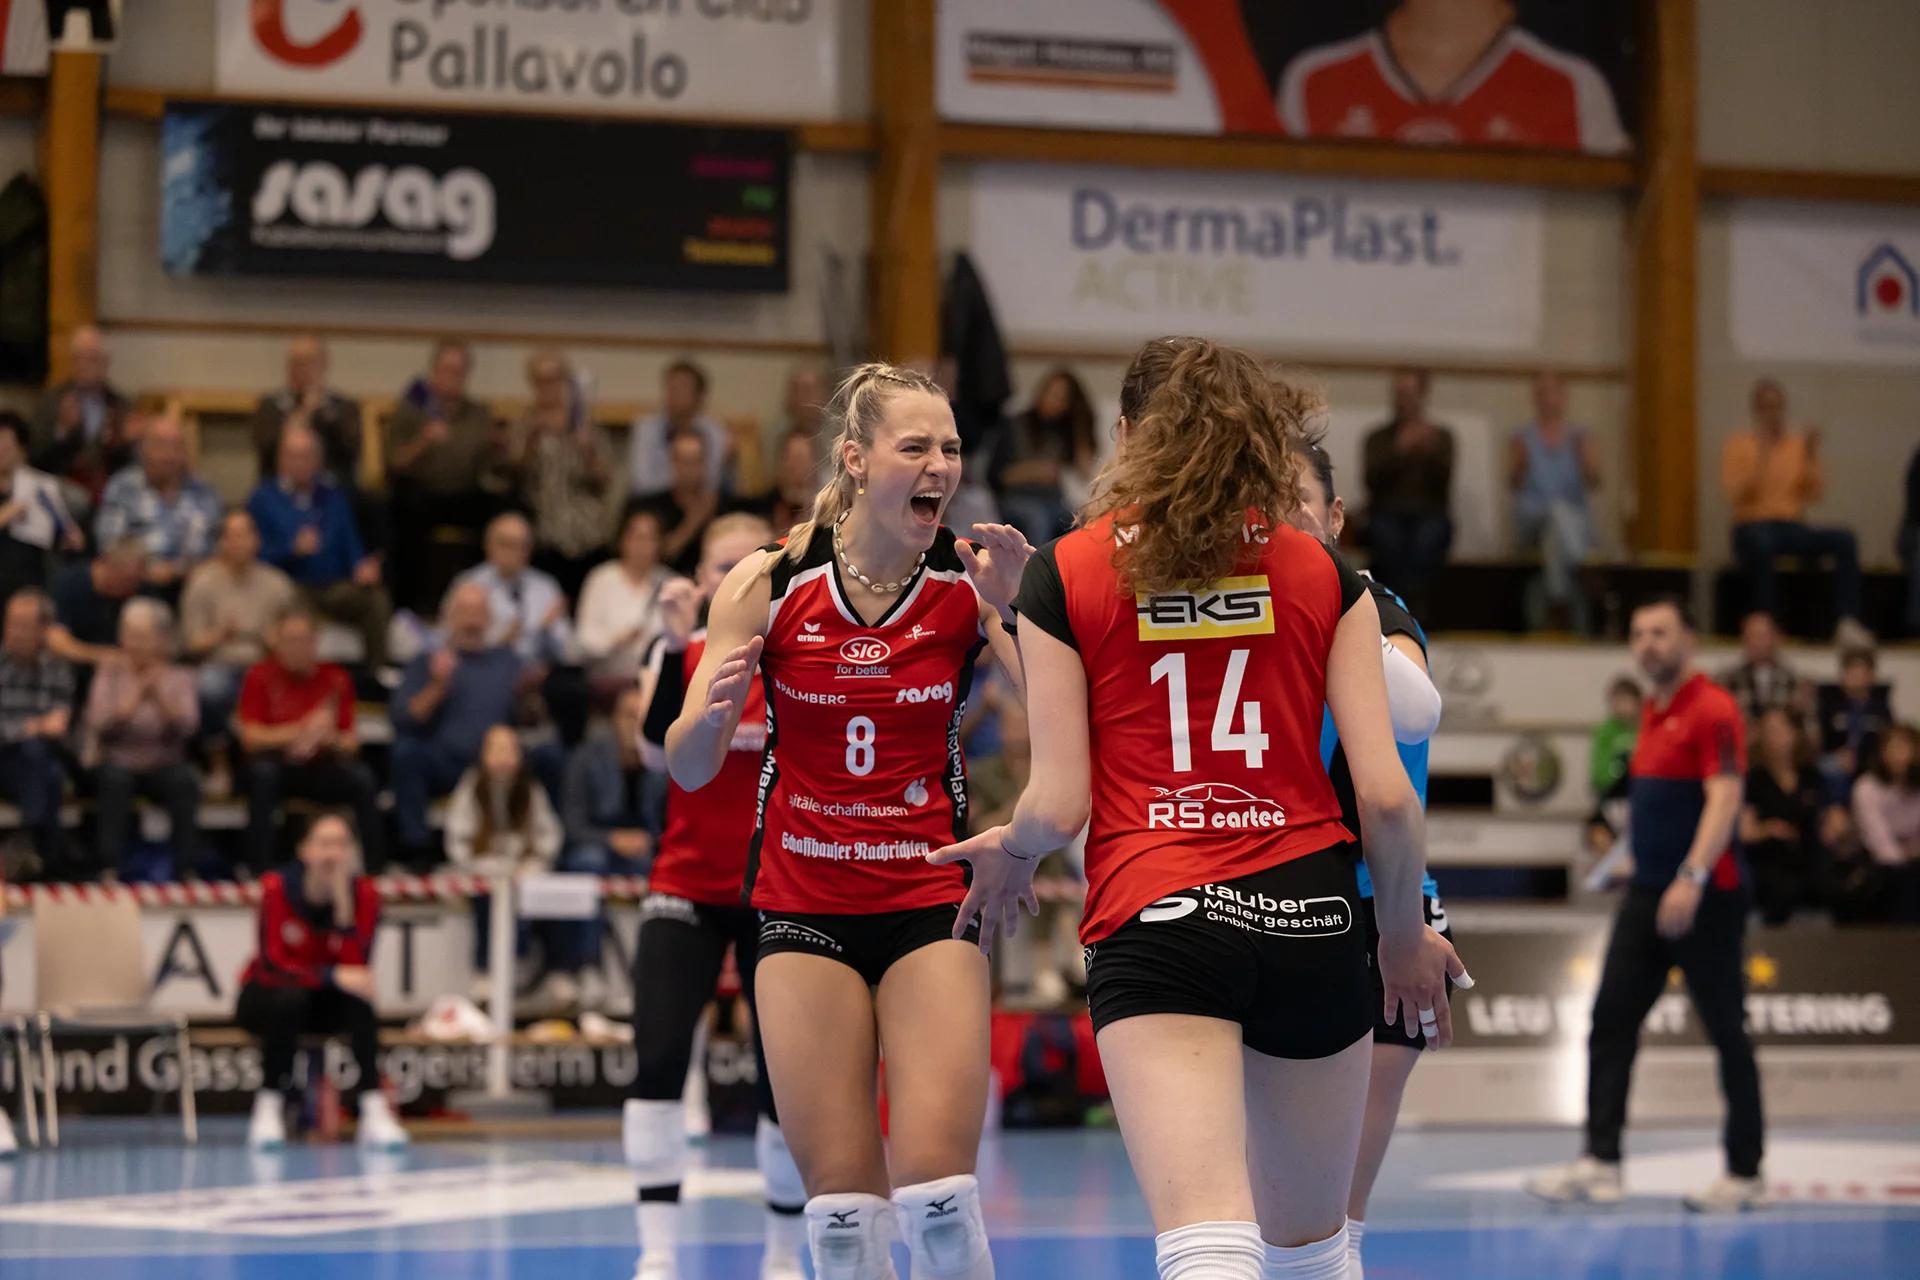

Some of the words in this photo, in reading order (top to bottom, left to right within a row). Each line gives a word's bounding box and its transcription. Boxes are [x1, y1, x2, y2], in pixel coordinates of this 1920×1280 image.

[390, 20, 687, 99] Pallavolo
[253, 159, 497, 260] sasag
[797, 634, 825, 642] erima
[846, 643, 882, 658] SIG
[836, 664, 852, 675] for
[856, 664, 888, 675] better
[781, 683, 847, 704] PALMBERG
[895, 681, 953, 703] sasag
[1150, 649, 1269, 771] 14
[845, 715, 875, 777] 8
[823, 803, 908, 816] schaffhausen
[1148, 803, 1206, 829] RS
[1211, 805, 1286, 829] cartec
[1206, 911, 1250, 931] GmbH
[1743, 992, 1893, 1035] TERING
